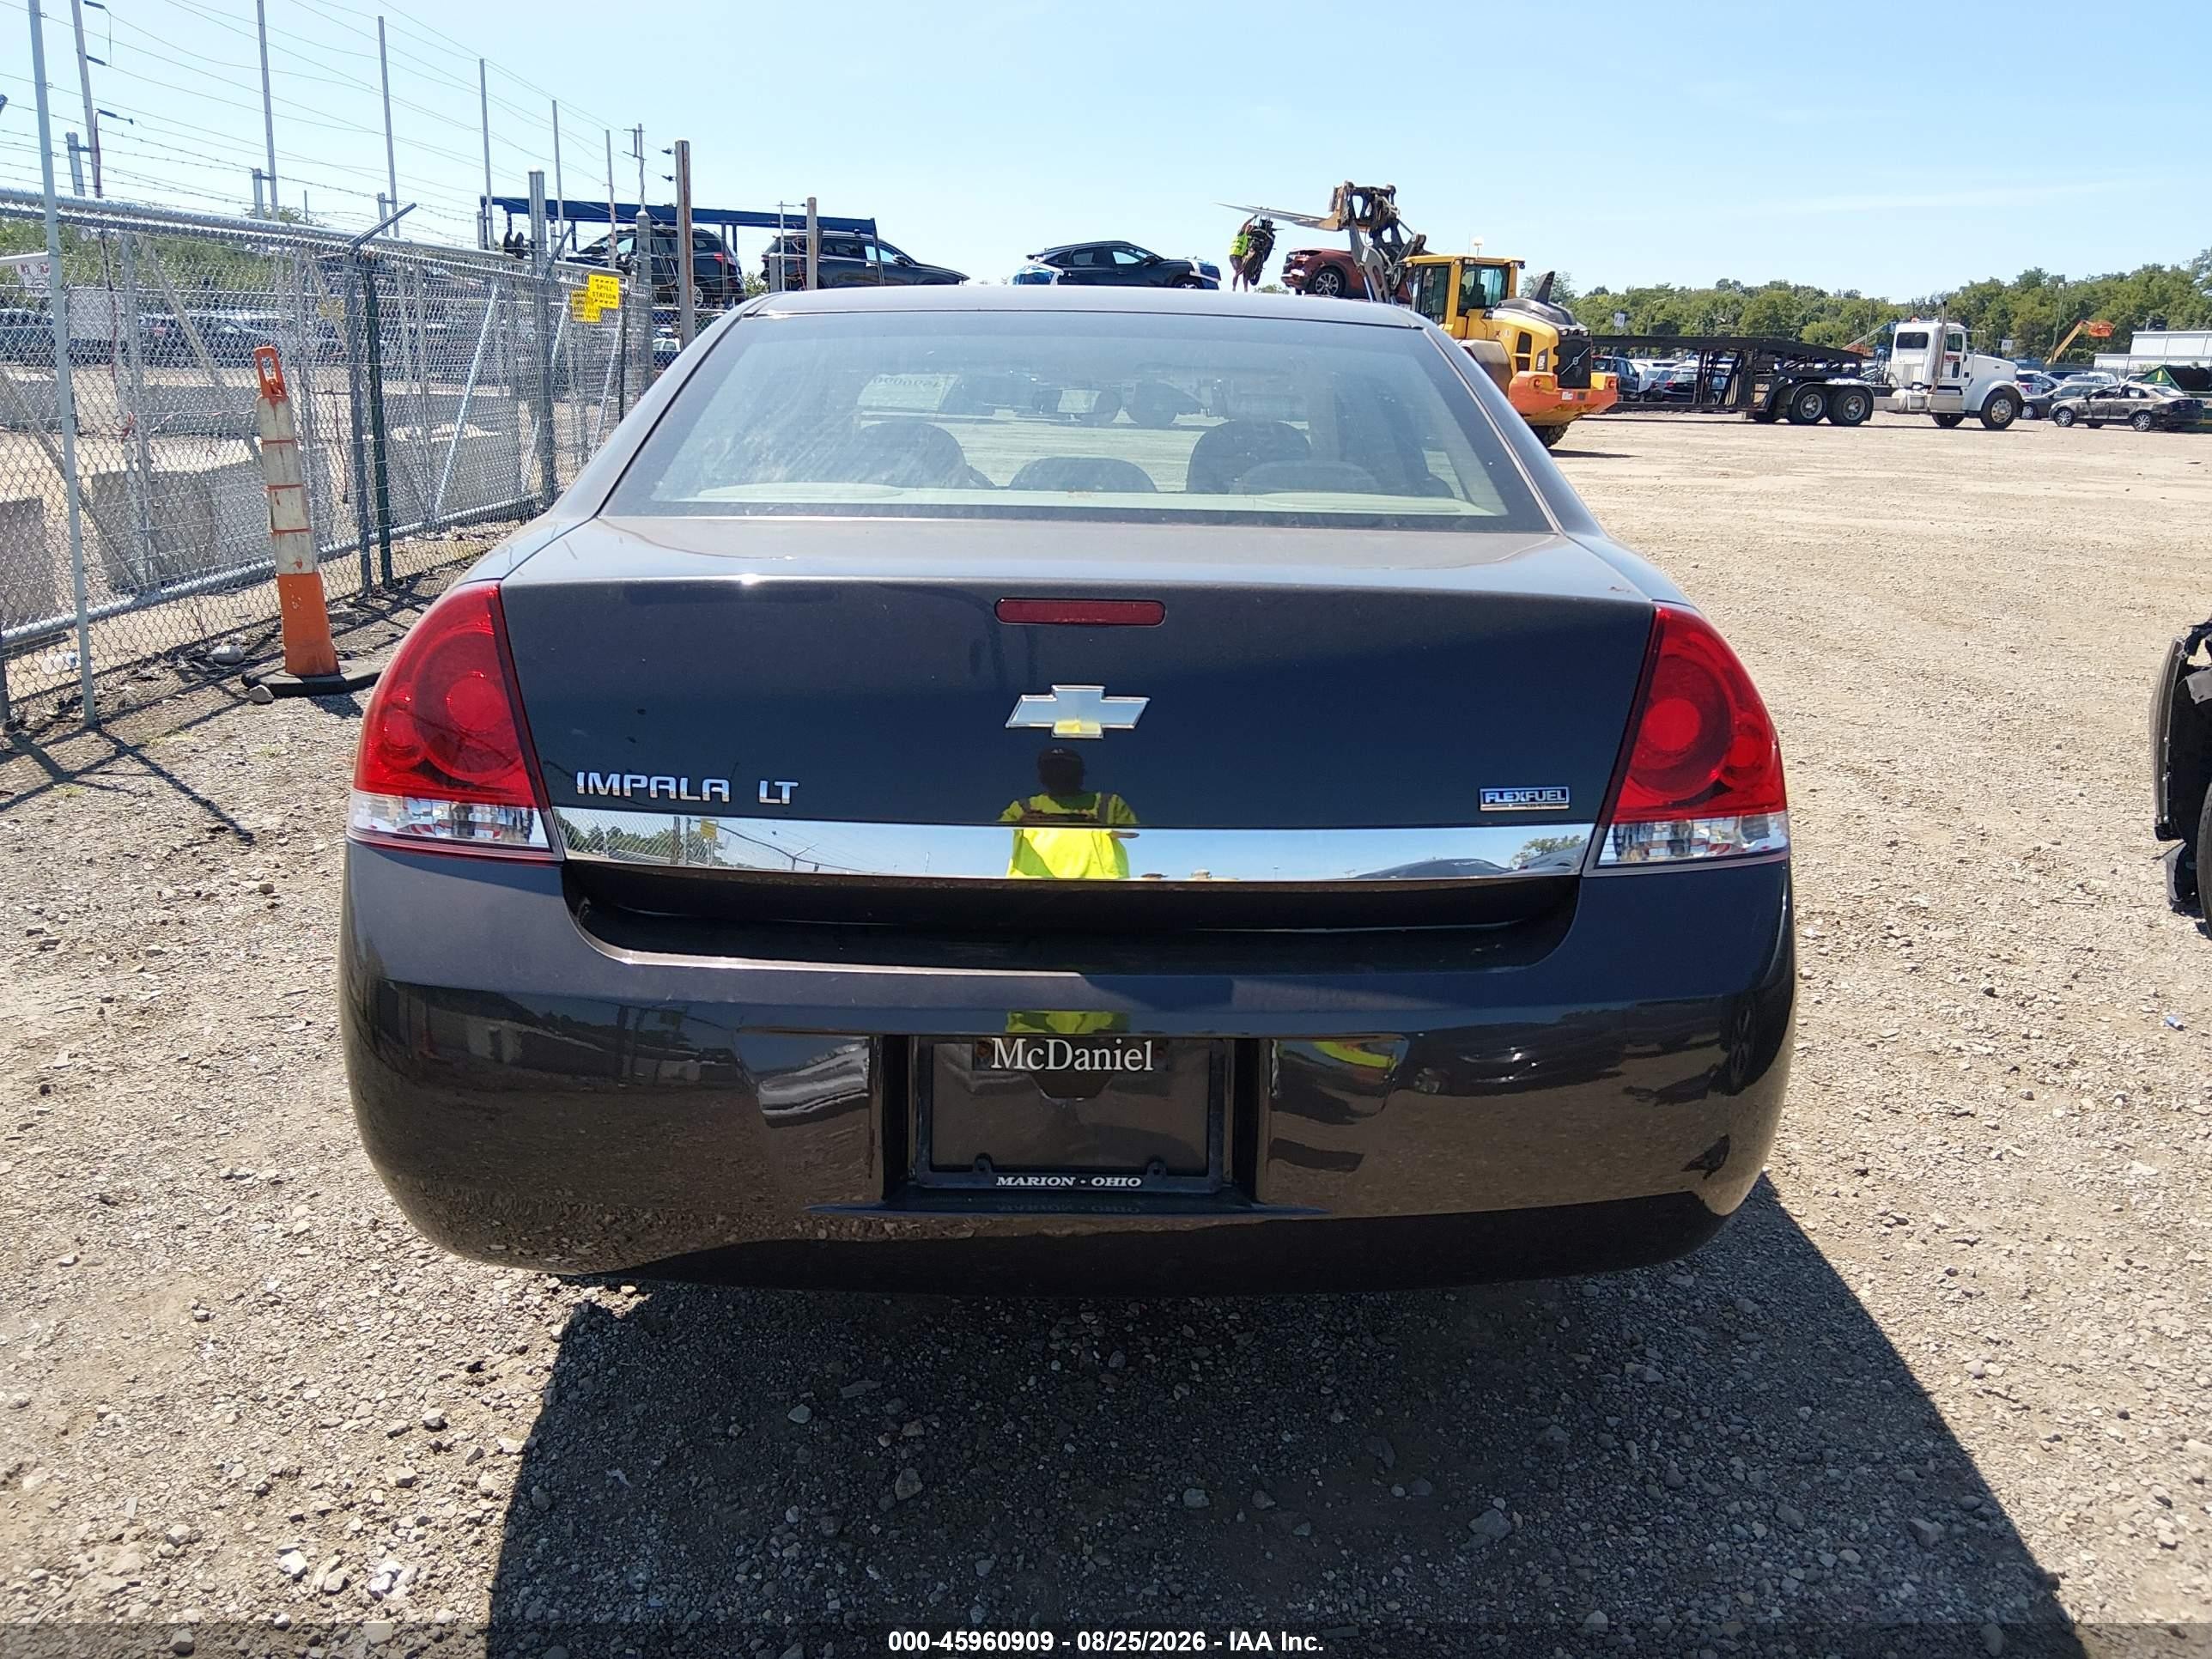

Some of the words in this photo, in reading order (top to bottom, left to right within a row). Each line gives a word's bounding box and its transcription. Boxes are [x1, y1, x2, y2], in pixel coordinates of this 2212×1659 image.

[576, 771, 730, 803] IMPALA
[758, 780, 799, 805] LT
[1484, 789, 1566, 804] FLEXFUEL
[990, 1037, 1155, 1072] McDaniel
[996, 1176, 1077, 1187] MARION
[1091, 1176, 1142, 1188] OHIO
